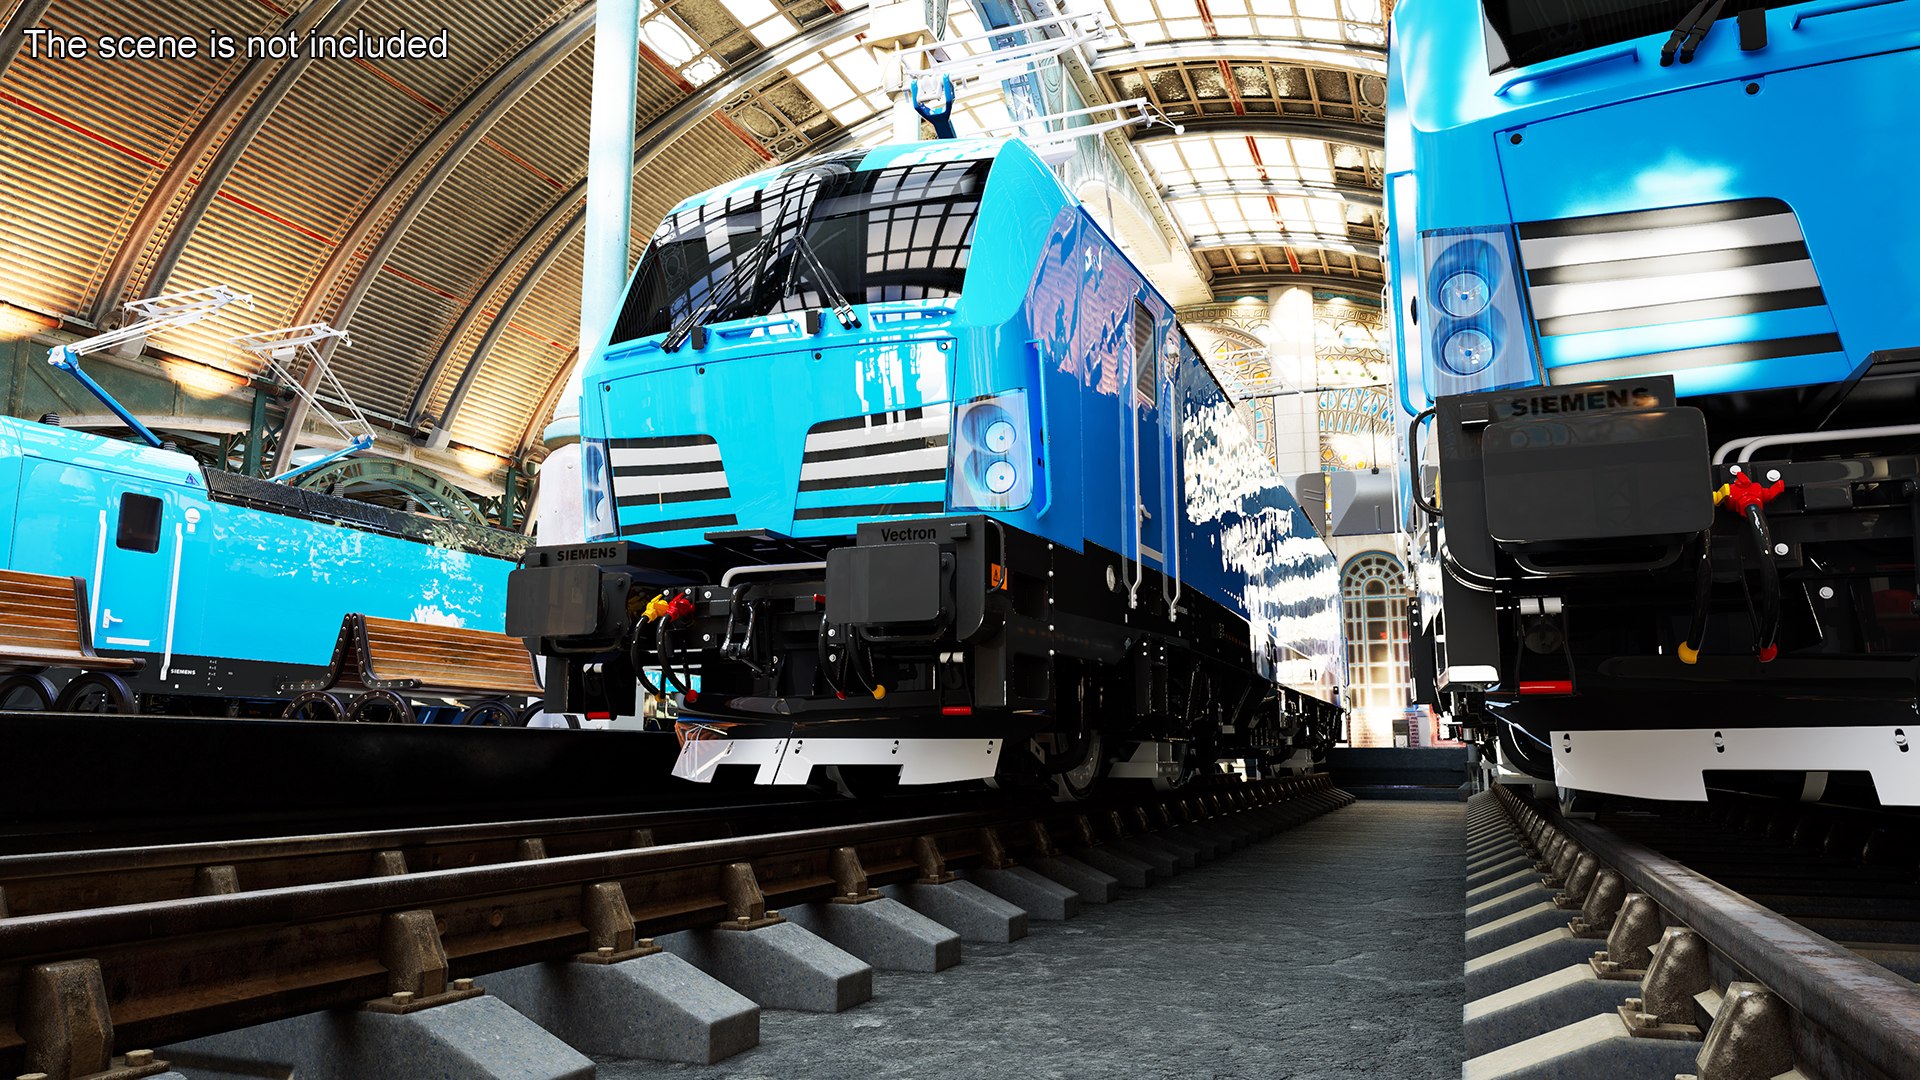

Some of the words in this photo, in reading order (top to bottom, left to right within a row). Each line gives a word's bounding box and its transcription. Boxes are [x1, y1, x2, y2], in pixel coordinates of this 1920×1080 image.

[1511, 387, 1656, 416] SIEMENS
[880, 528, 937, 542] Vectron
[557, 547, 617, 561] SIEMENS
